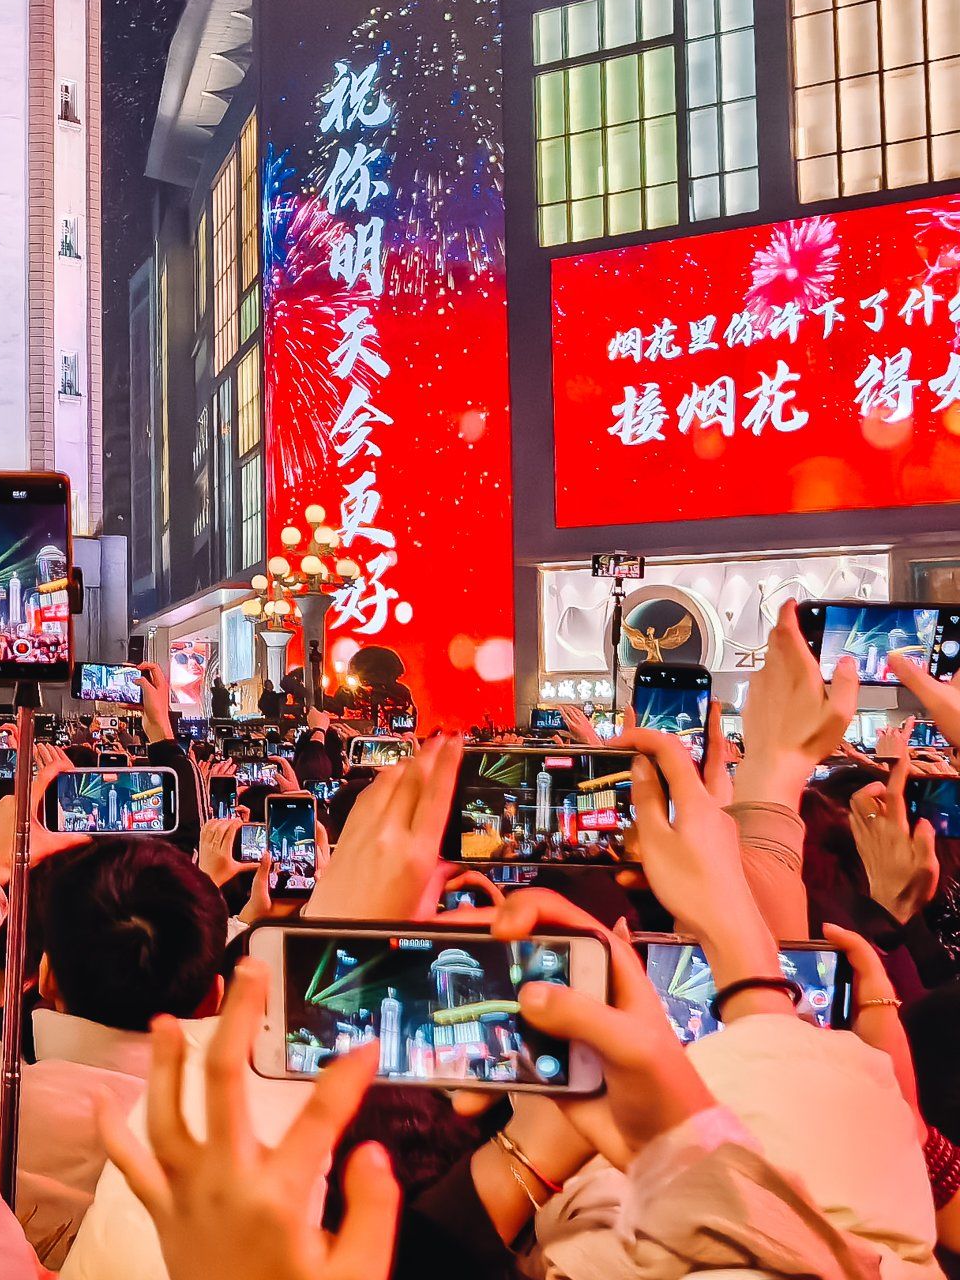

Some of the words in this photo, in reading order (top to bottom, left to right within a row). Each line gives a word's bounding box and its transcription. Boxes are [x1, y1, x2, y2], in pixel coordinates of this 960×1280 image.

[319, 61, 401, 634] 祝你明天会更好
[608, 285, 960, 363] 烟花里你许下了什
[607, 360, 809, 446] 接烟花
